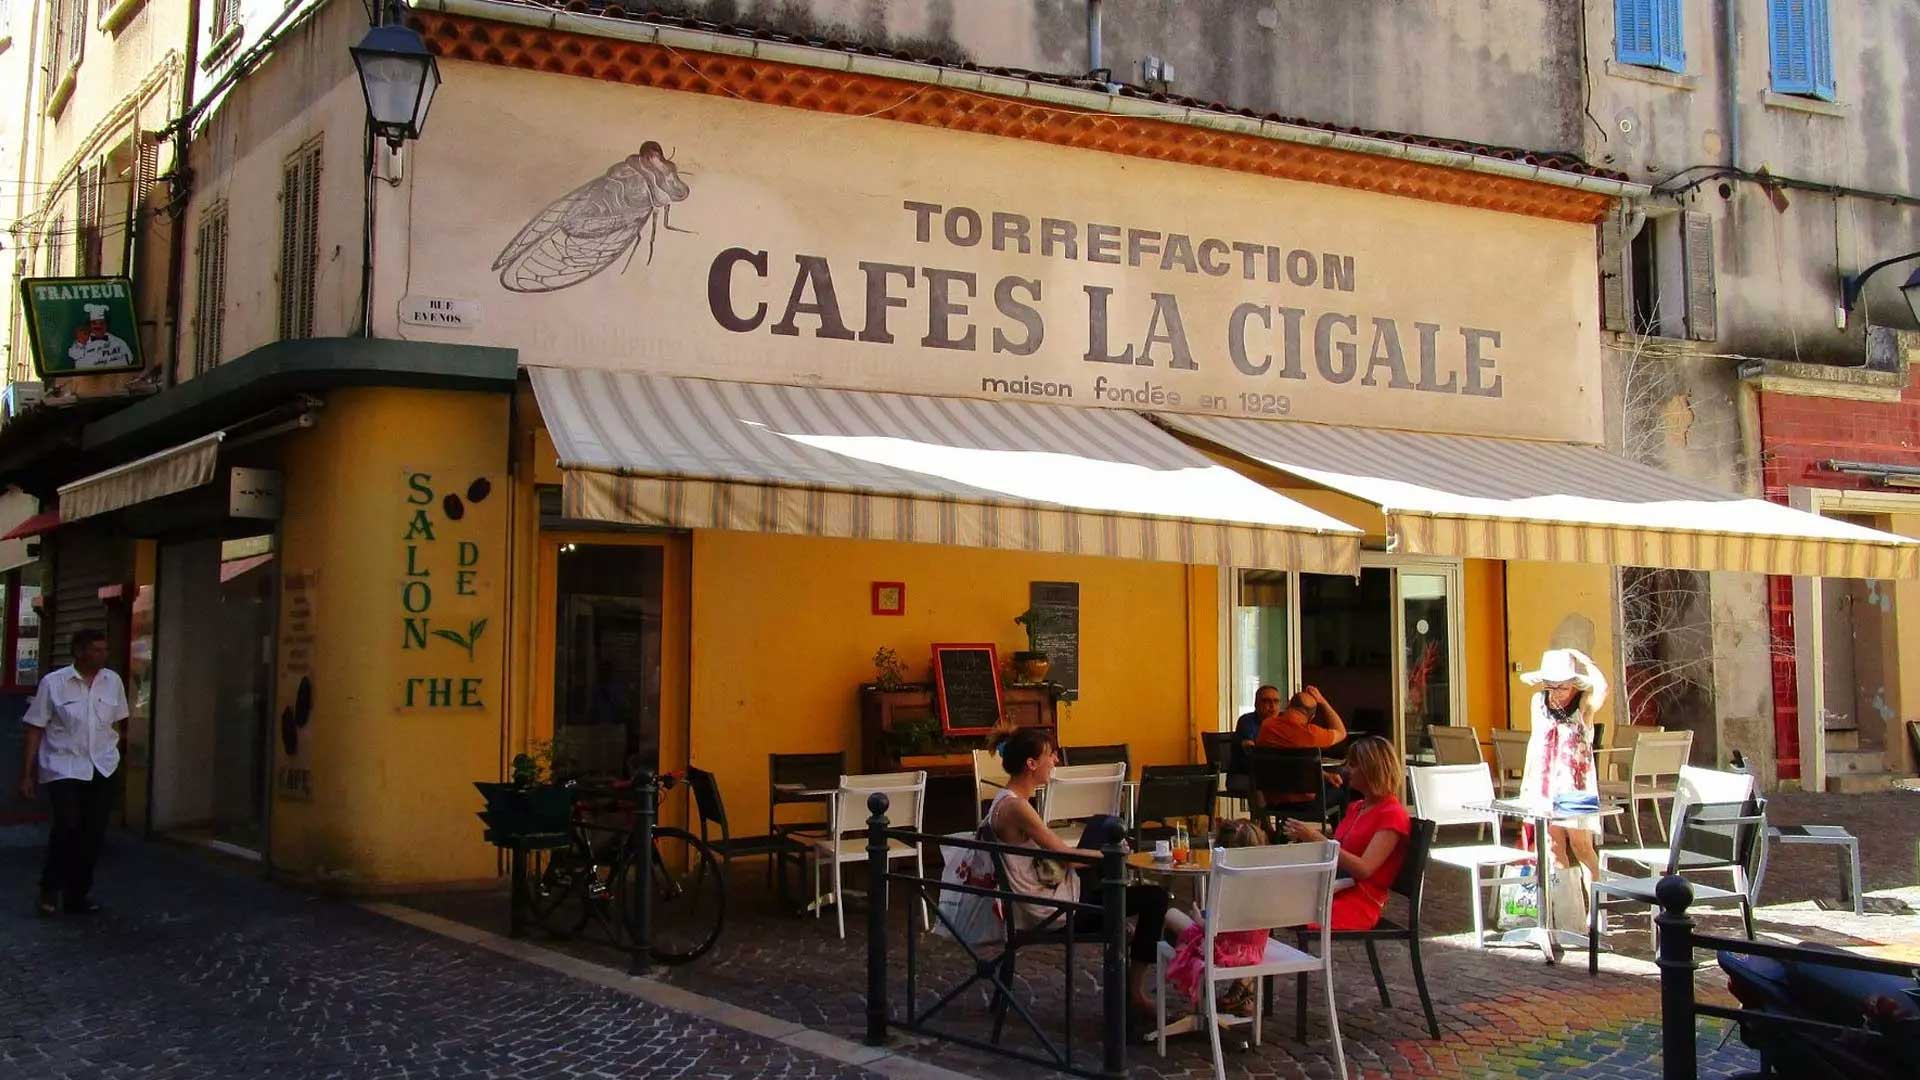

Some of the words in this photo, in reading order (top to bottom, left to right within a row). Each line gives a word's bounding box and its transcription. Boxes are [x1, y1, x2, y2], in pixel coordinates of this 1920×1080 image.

[904, 200, 1356, 292] TORREFACTION
[35, 284, 125, 300] TRAITEUR
[429, 300, 455, 310] RUE
[414, 312, 462, 323] EVENOS
[708, 246, 1045, 357] CAFES
[1083, 284, 1199, 371] LA
[1228, 302, 1503, 398] CIGALE
[982, 376, 1073, 398] maison
[1094, 376, 1181, 405] fondée
[1200, 394, 1227, 410] en
[1239, 392, 1291, 415] 1929
[403, 473, 436, 649] SALON
[456, 541, 479, 596] DE
